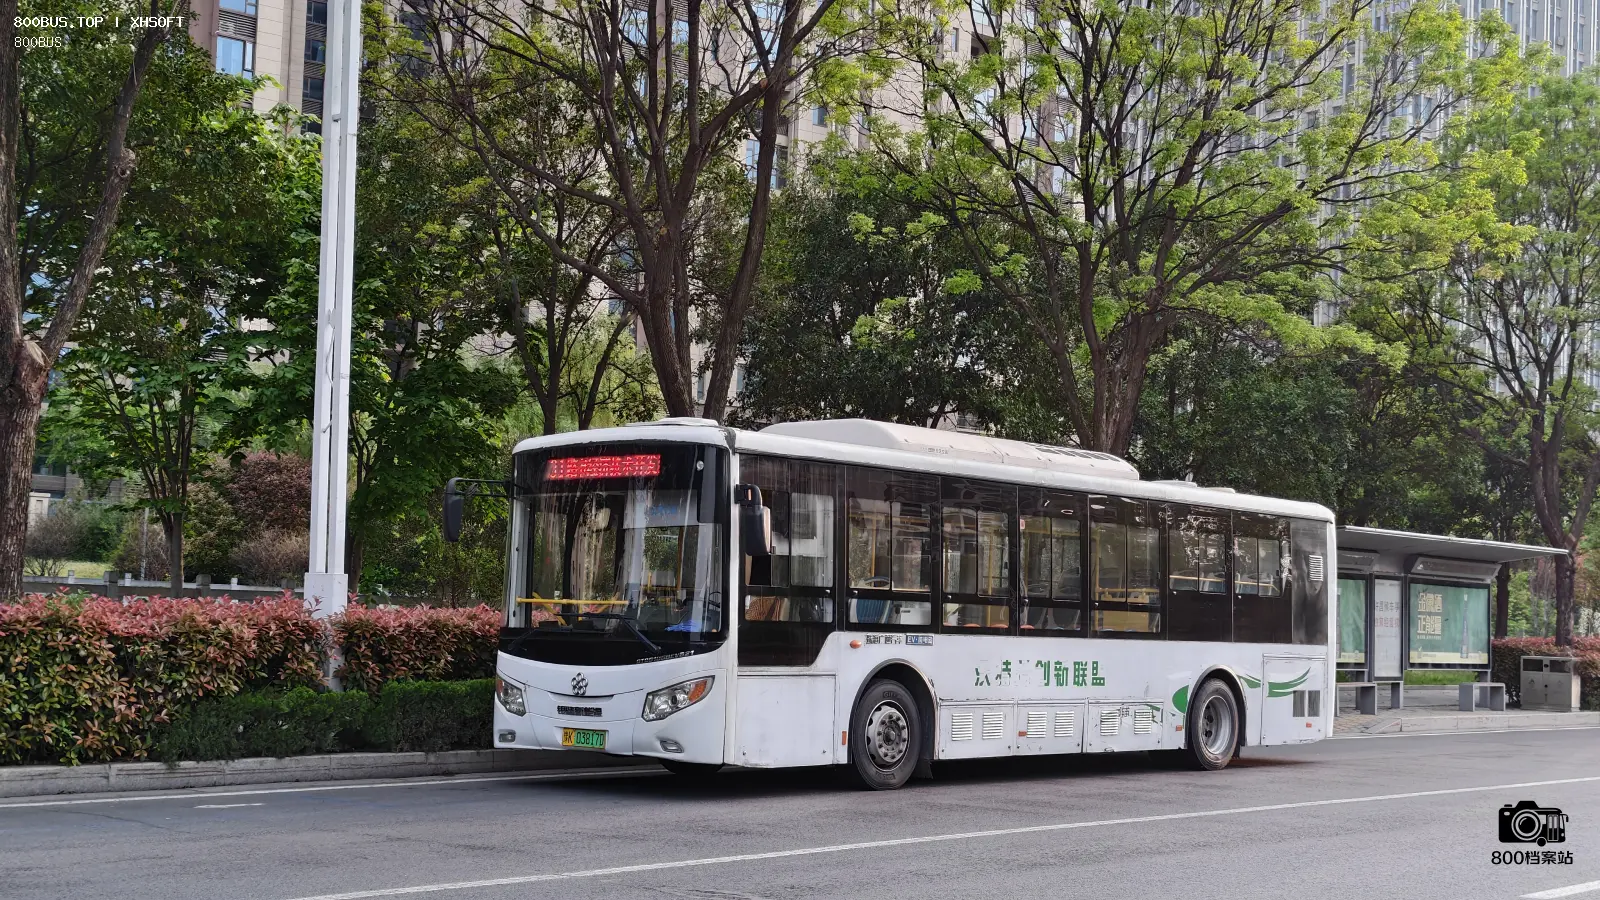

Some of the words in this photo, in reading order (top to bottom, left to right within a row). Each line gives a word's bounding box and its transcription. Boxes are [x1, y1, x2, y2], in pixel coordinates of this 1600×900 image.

[1416, 615, 1442, 635] 正能量
[974, 659, 1106, 687] 特创新联盟
